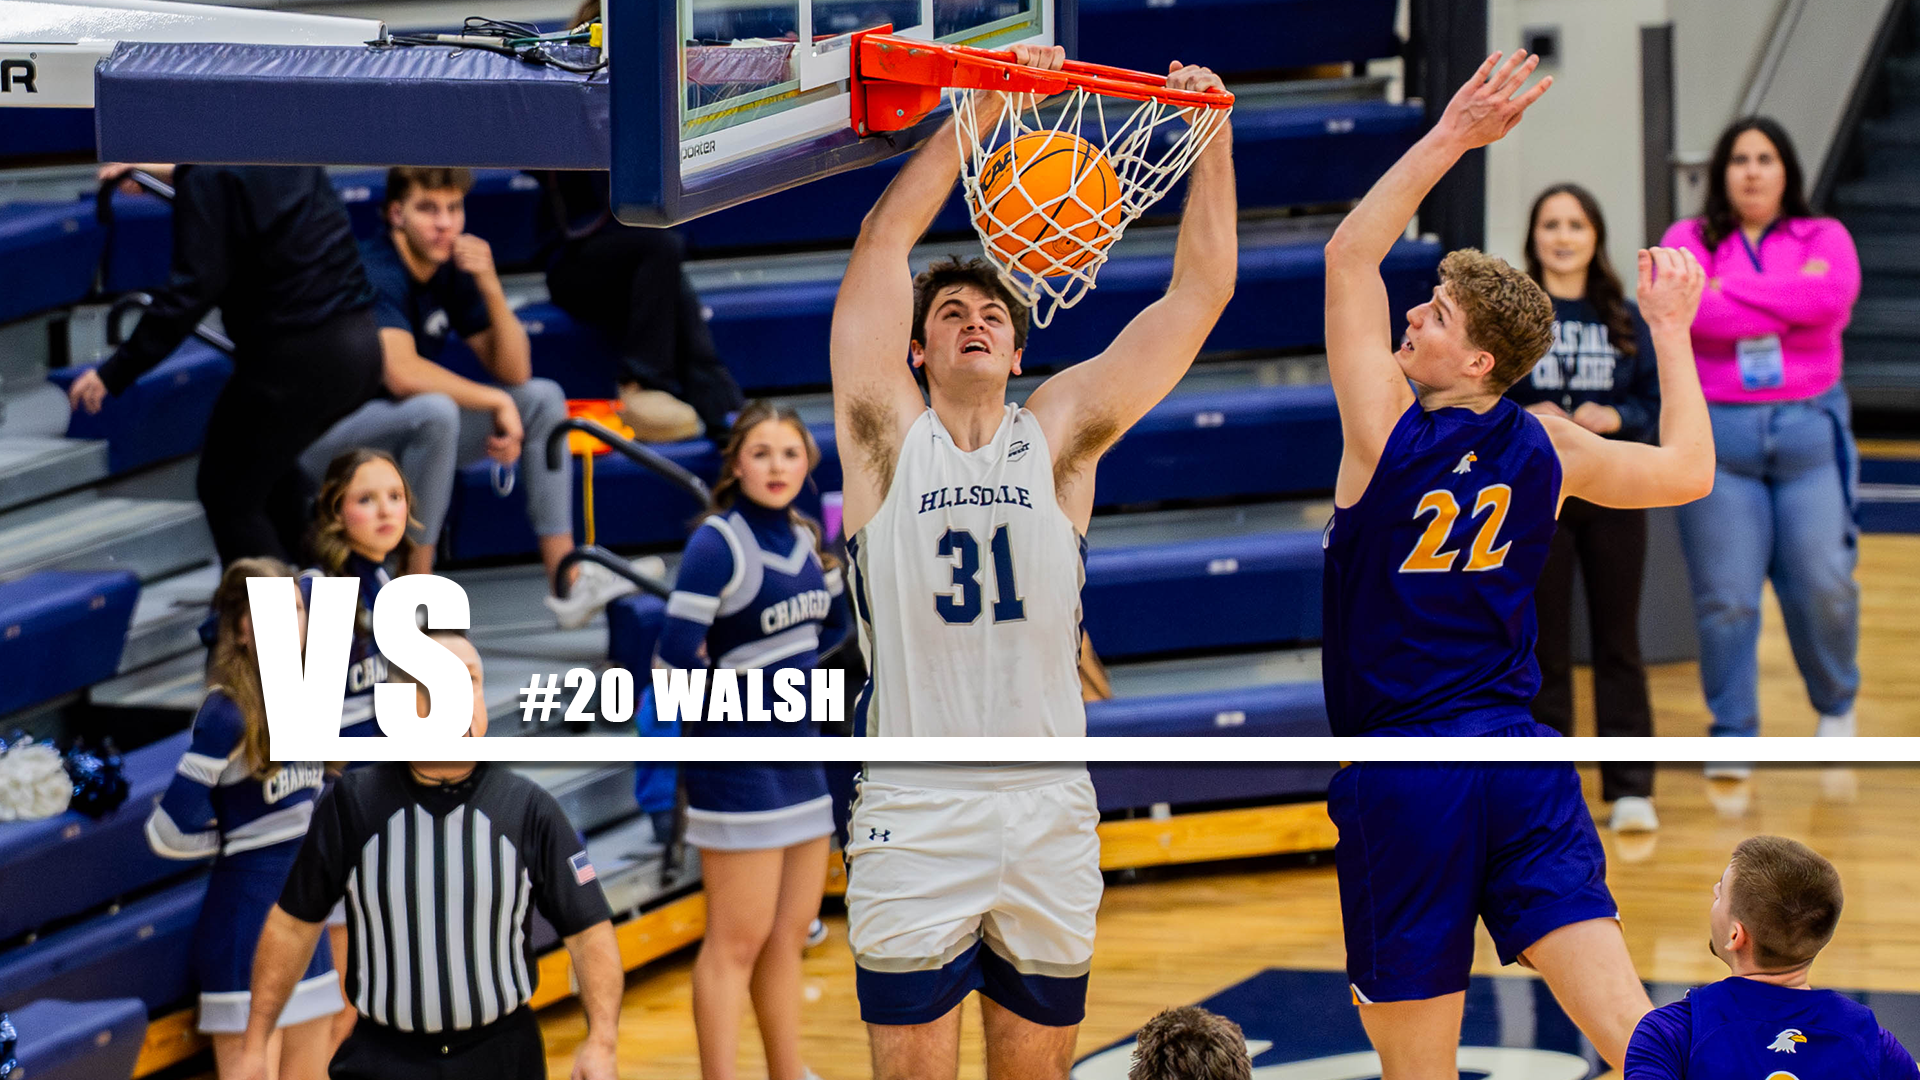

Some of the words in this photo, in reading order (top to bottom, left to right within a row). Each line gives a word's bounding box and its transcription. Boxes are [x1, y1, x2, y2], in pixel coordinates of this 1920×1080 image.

[980, 150, 1019, 192] CAA
[918, 485, 1033, 514] HILSDLE
[1398, 483, 1513, 573] 22
[932, 522, 1028, 626] 31
